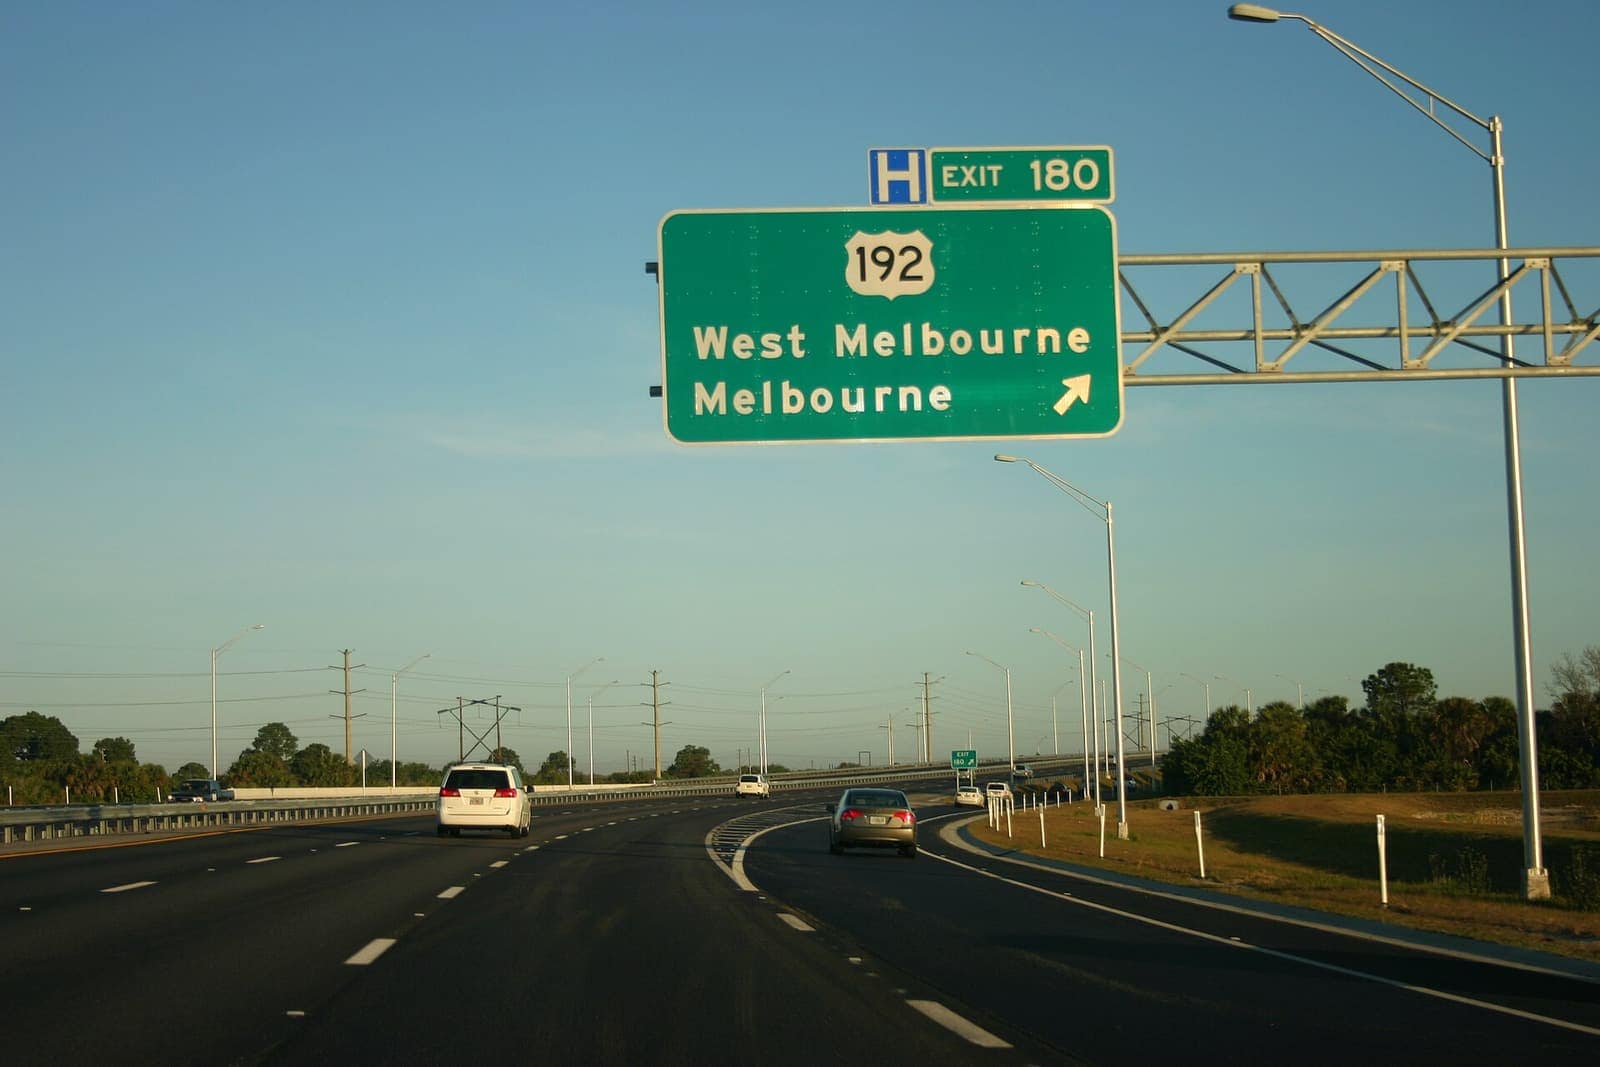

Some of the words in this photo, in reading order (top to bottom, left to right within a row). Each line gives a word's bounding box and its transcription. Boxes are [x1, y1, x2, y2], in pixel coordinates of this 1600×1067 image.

[877, 152, 920, 202] H
[942, 165, 1003, 187] EXIT
[1030, 158, 1100, 191] 180
[855, 245, 923, 282] 192
[693, 324, 806, 360] West
[835, 321, 1092, 358] Melbourne
[693, 380, 953, 416] Melbourne
